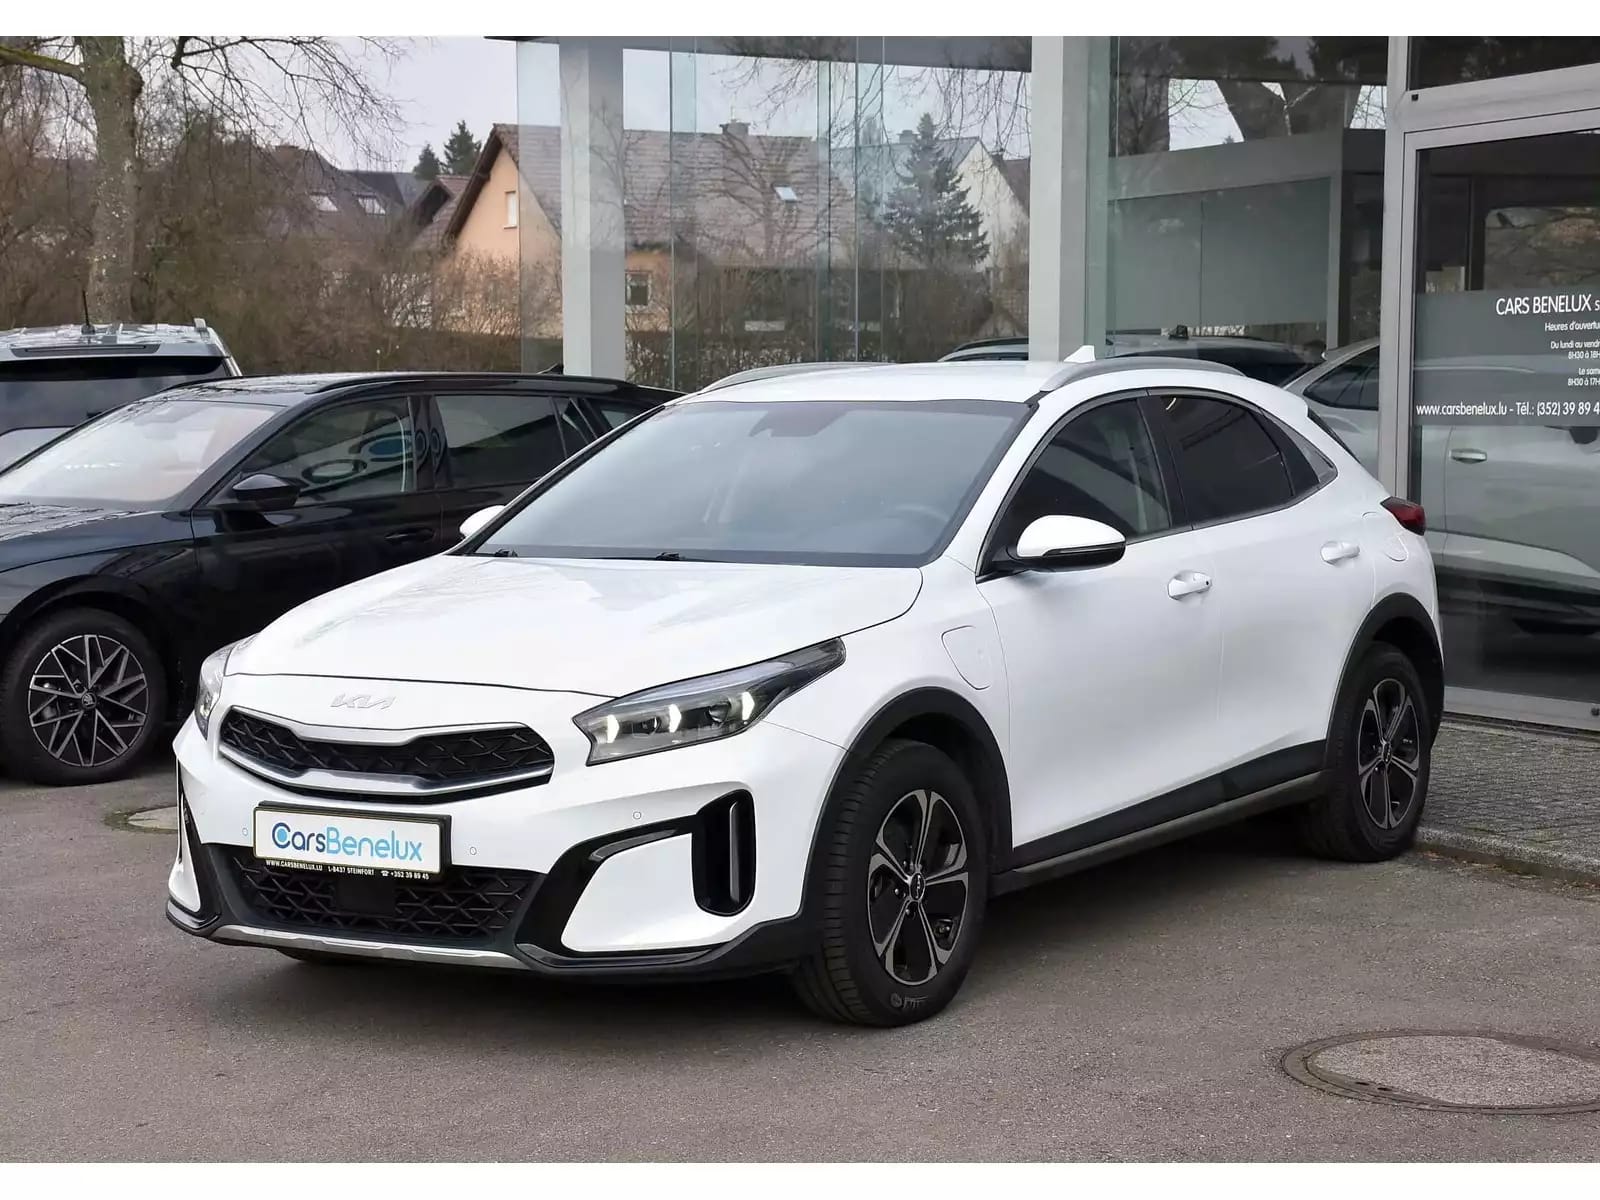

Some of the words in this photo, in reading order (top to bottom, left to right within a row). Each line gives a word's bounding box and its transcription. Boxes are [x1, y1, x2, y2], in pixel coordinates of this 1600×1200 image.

[1496, 296, 1530, 315] CARS
[1532, 294, 1592, 314] BENELUX
[1544, 322, 1568, 332] Heures
[1550, 341, 1559, 349] Du
[1559, 340, 1574, 349] lundi
[1568, 351, 1584, 360] 8H30
[1578, 367, 1586, 375] Le
[1567, 378, 1584, 386] 8H30
[1416, 401, 1507, 416] www.carsbenelux.lu
[1537, 401, 1561, 417] (352)
[1562, 402, 1575, 415] 39
[1577, 402, 1591, 415] 89
[1593, 402, 1600, 415] 4
[271, 822, 423, 863] CarsBenelux
[265, 859, 323, 872] WWW.CARSBENELUX.LU
[347, 867, 375, 876] STEINFORT
[390, 870, 405, 879] +352
